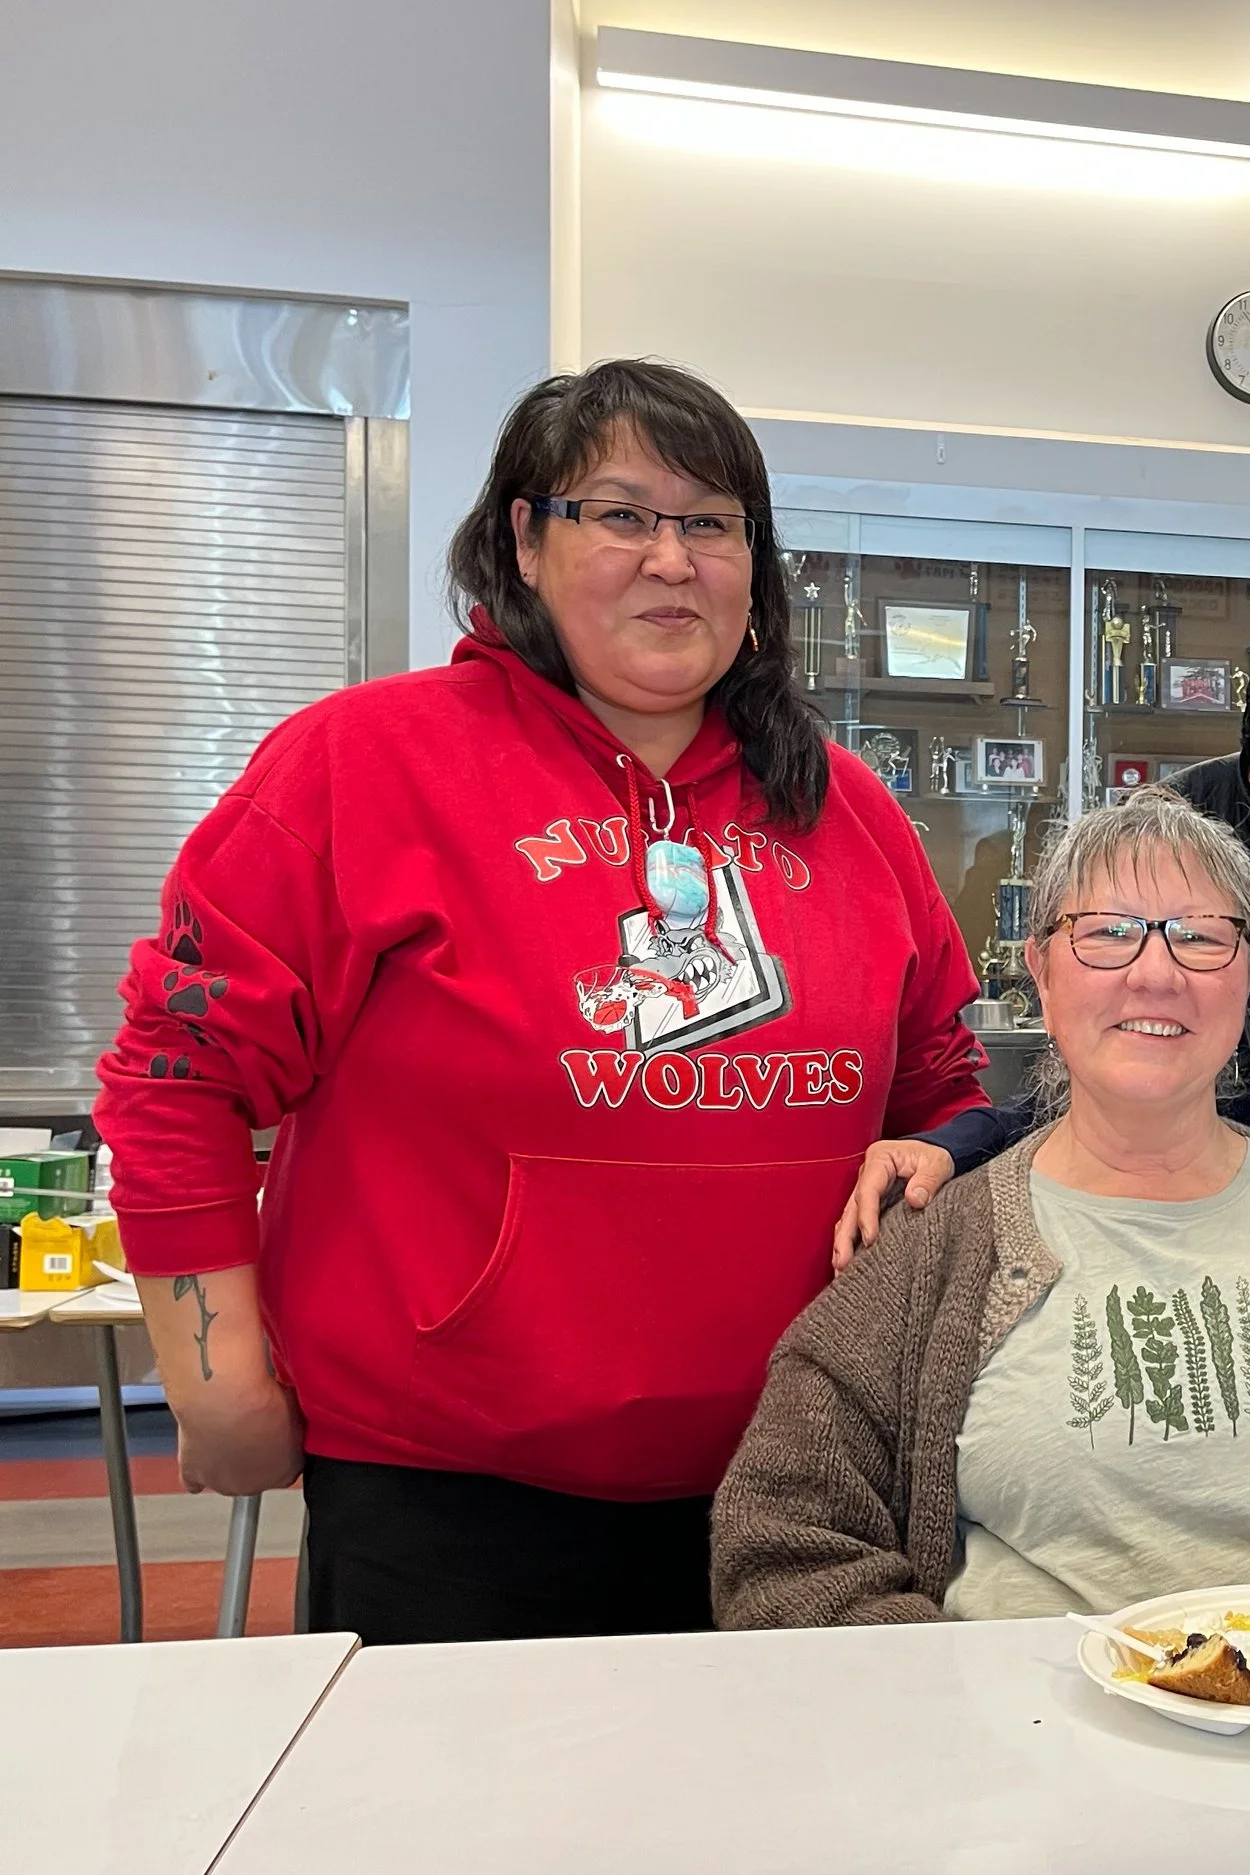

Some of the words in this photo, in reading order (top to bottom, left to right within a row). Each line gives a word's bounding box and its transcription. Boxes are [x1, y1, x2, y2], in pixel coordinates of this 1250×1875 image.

[1239, 300, 1247, 310] 11
[1224, 313, 1234, 324] 10
[1218, 335, 1225, 347] 9
[1224, 359, 1231, 370] 8
[1238, 375, 1245, 386] 7
[515, 816, 811, 891] NUTO
[560, 1049, 864, 1110] WOLVES
